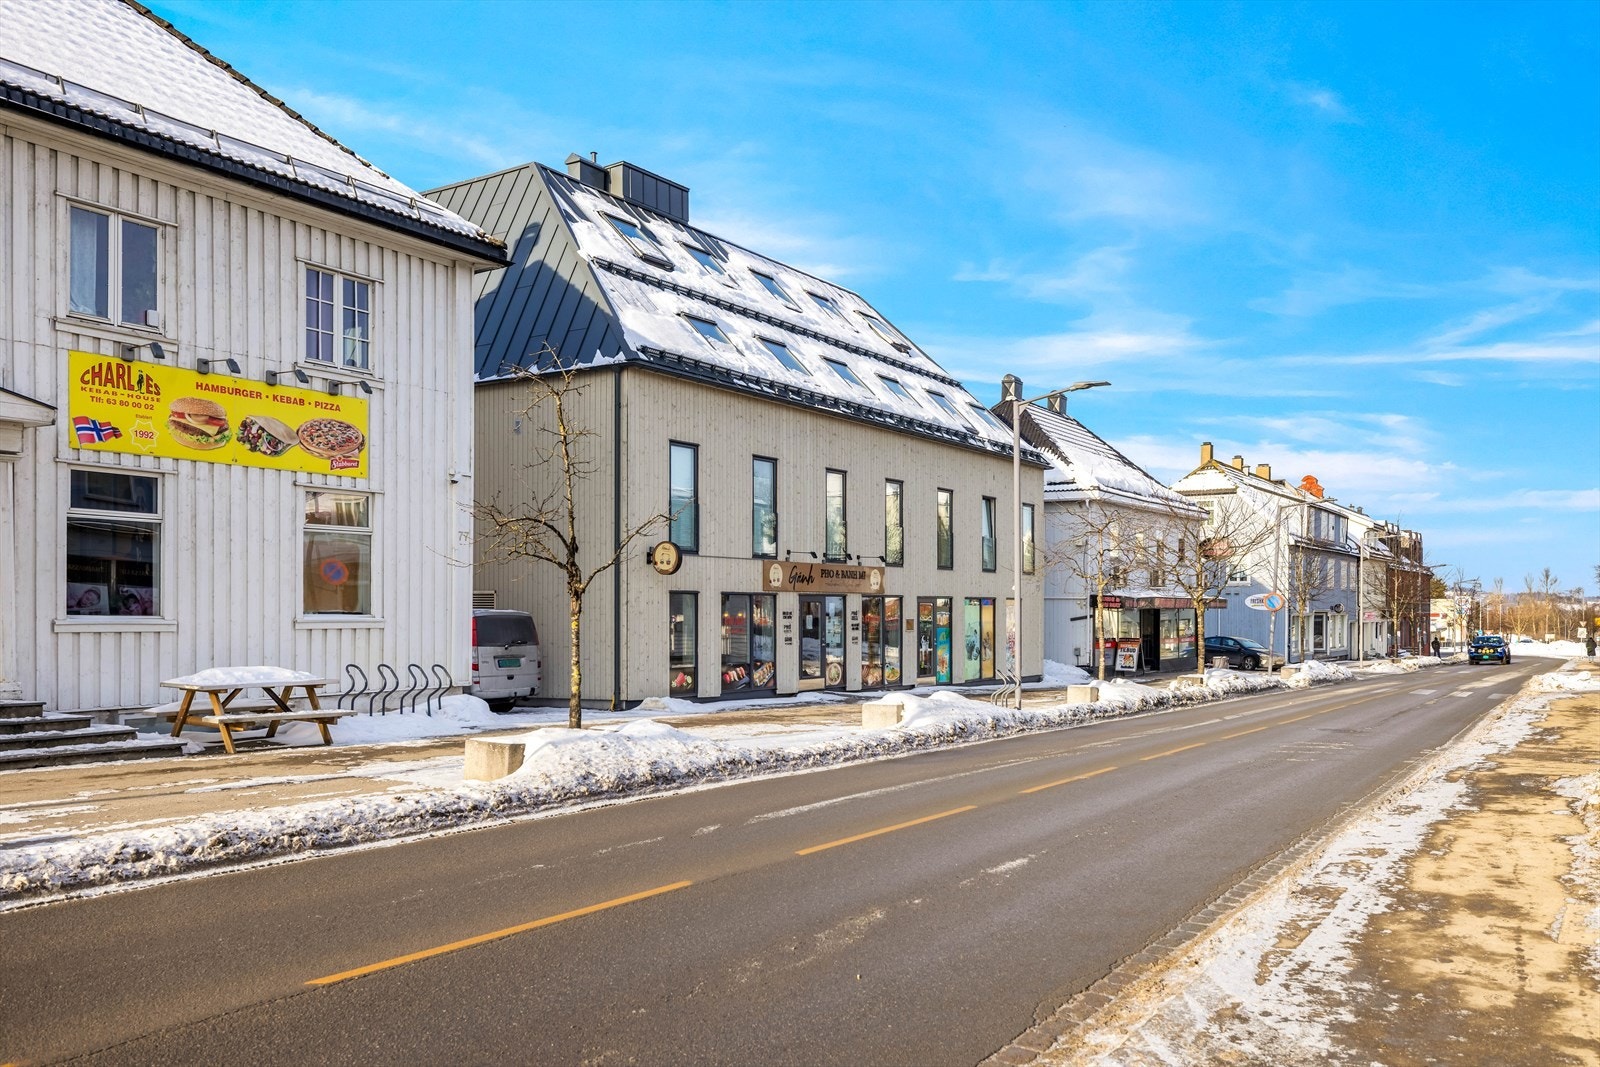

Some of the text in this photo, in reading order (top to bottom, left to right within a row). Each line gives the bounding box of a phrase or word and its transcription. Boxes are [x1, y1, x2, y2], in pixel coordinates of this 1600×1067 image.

[80, 362, 161, 396] CHARLIES
[90, 396, 104, 404] Tlf:
[195, 381, 341, 412] HAMBURGER KEBAB PIZZA
[134, 430, 154, 440] 1992
[820, 569, 834, 579] PHO
